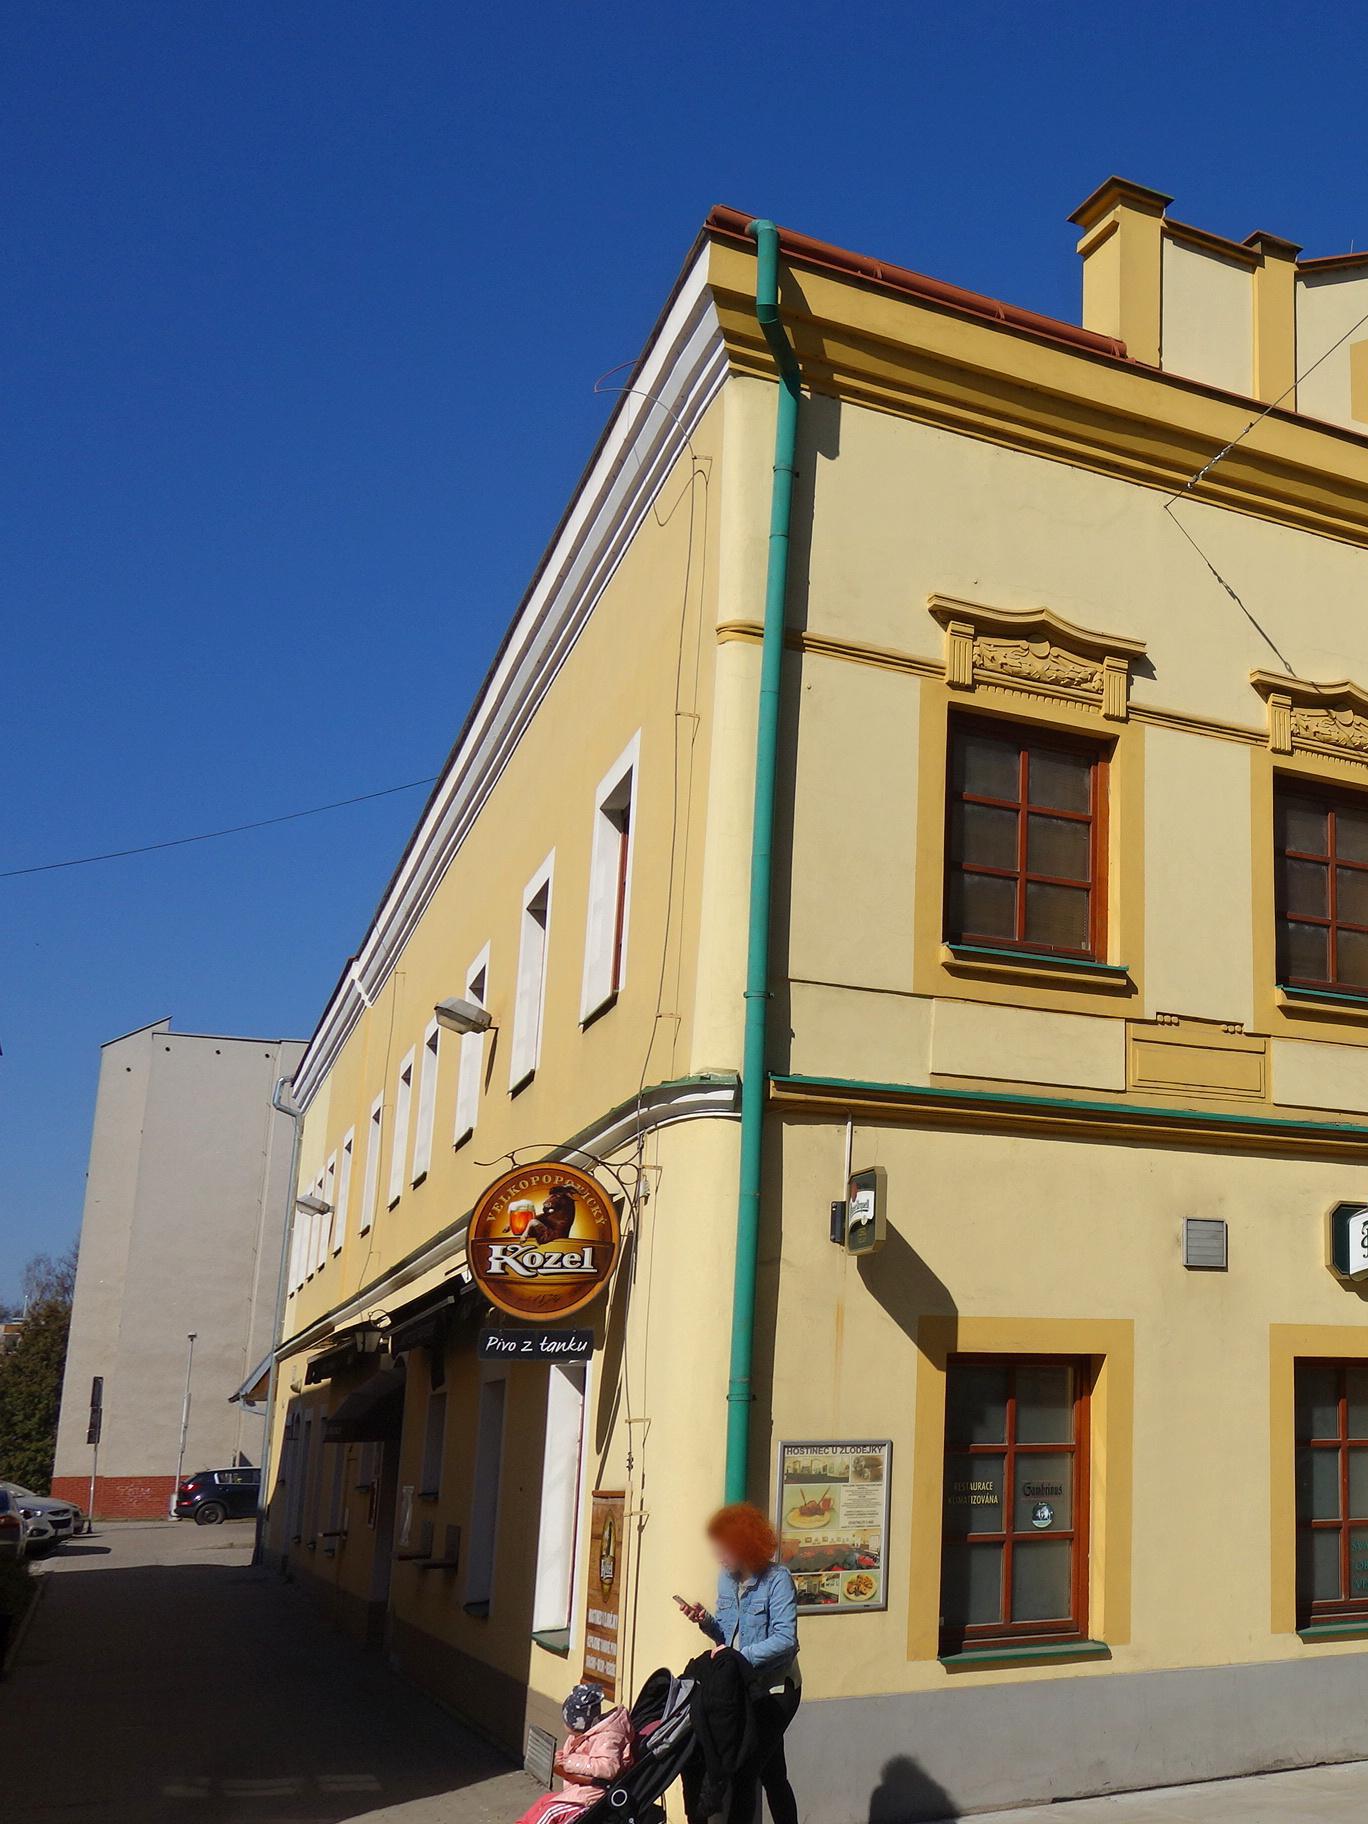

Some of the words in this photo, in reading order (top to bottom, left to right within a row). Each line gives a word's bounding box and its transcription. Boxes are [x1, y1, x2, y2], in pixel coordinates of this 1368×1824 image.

[486, 1244, 597, 1277] Kozel
[485, 1336, 517, 1352] Pivo
[520, 1341, 533, 1352] z
[540, 1336, 588, 1352] tanku
[786, 1447, 830, 1455] HOSTINEC
